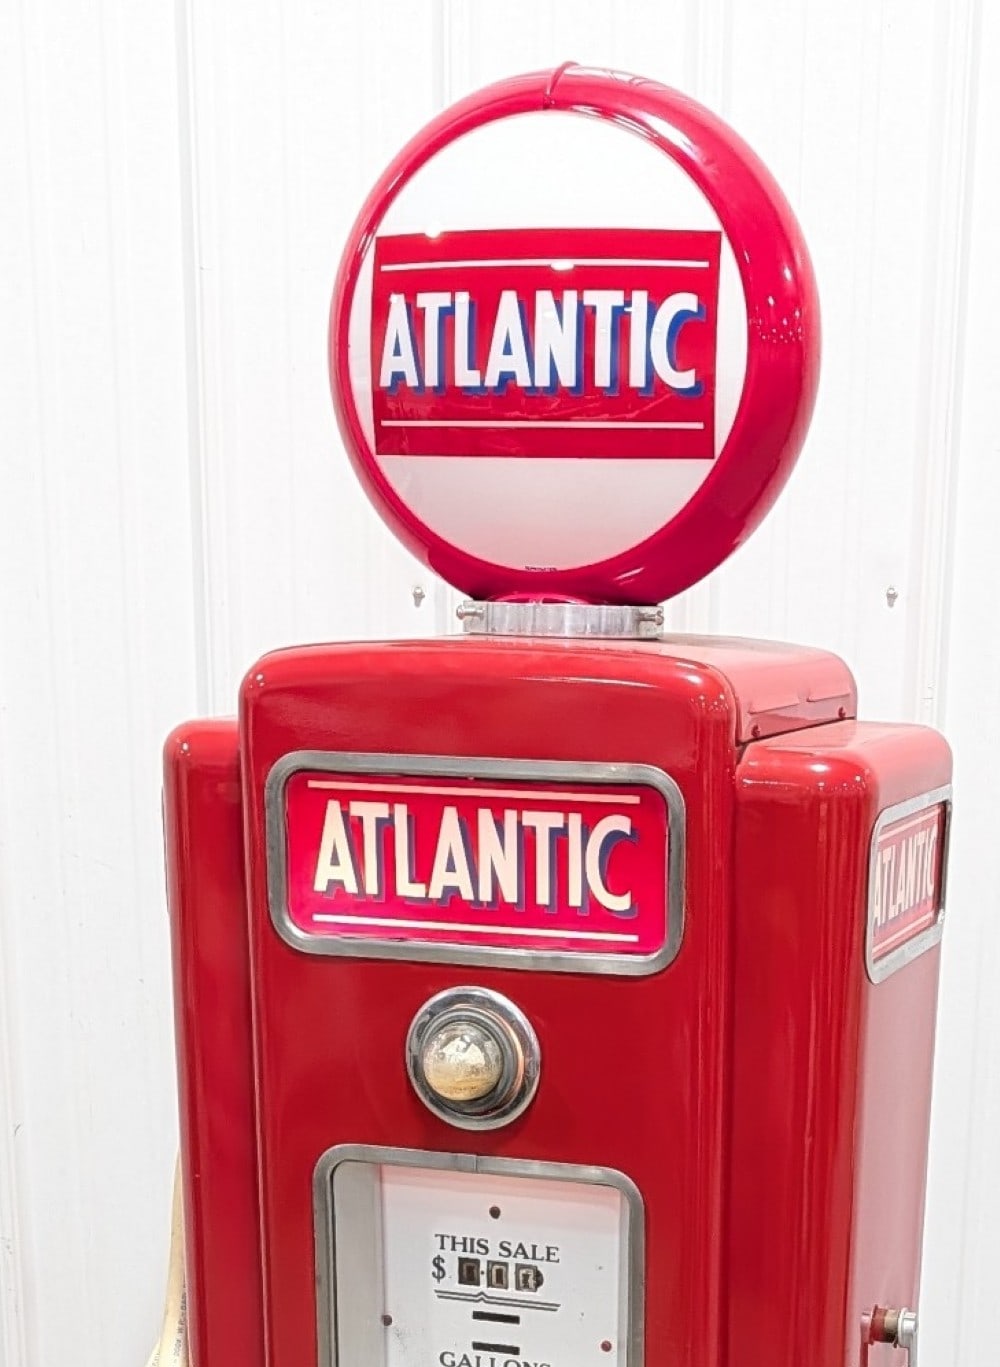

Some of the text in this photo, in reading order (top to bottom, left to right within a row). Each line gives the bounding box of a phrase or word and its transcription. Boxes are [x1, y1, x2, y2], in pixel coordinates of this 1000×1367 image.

[379, 290, 703, 394] ATLANTIC
[313, 799, 635, 914] ATLANTIC
[874, 824, 938, 928] ATLANTIC
[432, 1254, 446, 1284] $
[434, 1233, 560, 1263] THIS SALE
